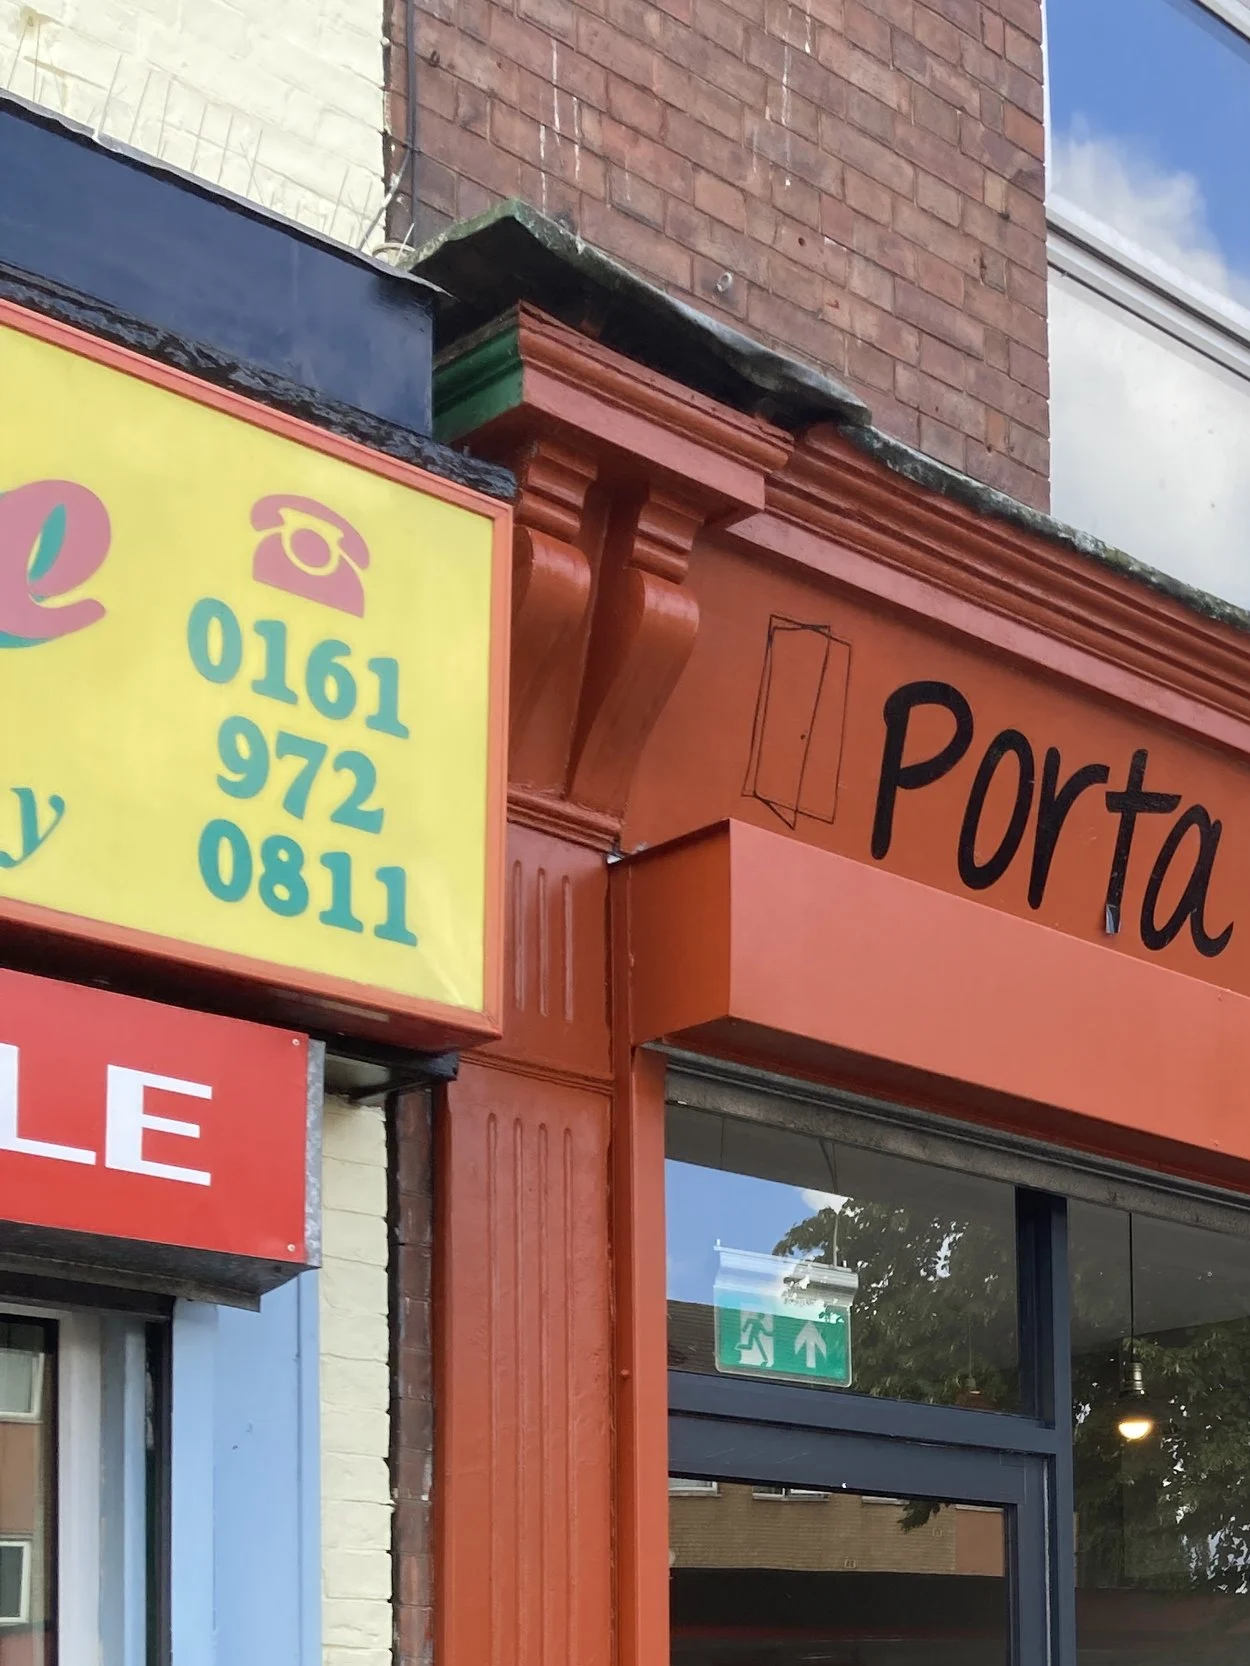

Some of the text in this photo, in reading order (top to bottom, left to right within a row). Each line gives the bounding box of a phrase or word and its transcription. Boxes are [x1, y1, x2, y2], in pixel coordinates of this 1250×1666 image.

[187, 598, 410, 739] 0161
[216, 716, 385, 835] 972
[871, 680, 1233, 958] Porta
[198, 819, 418, 946] 0811
